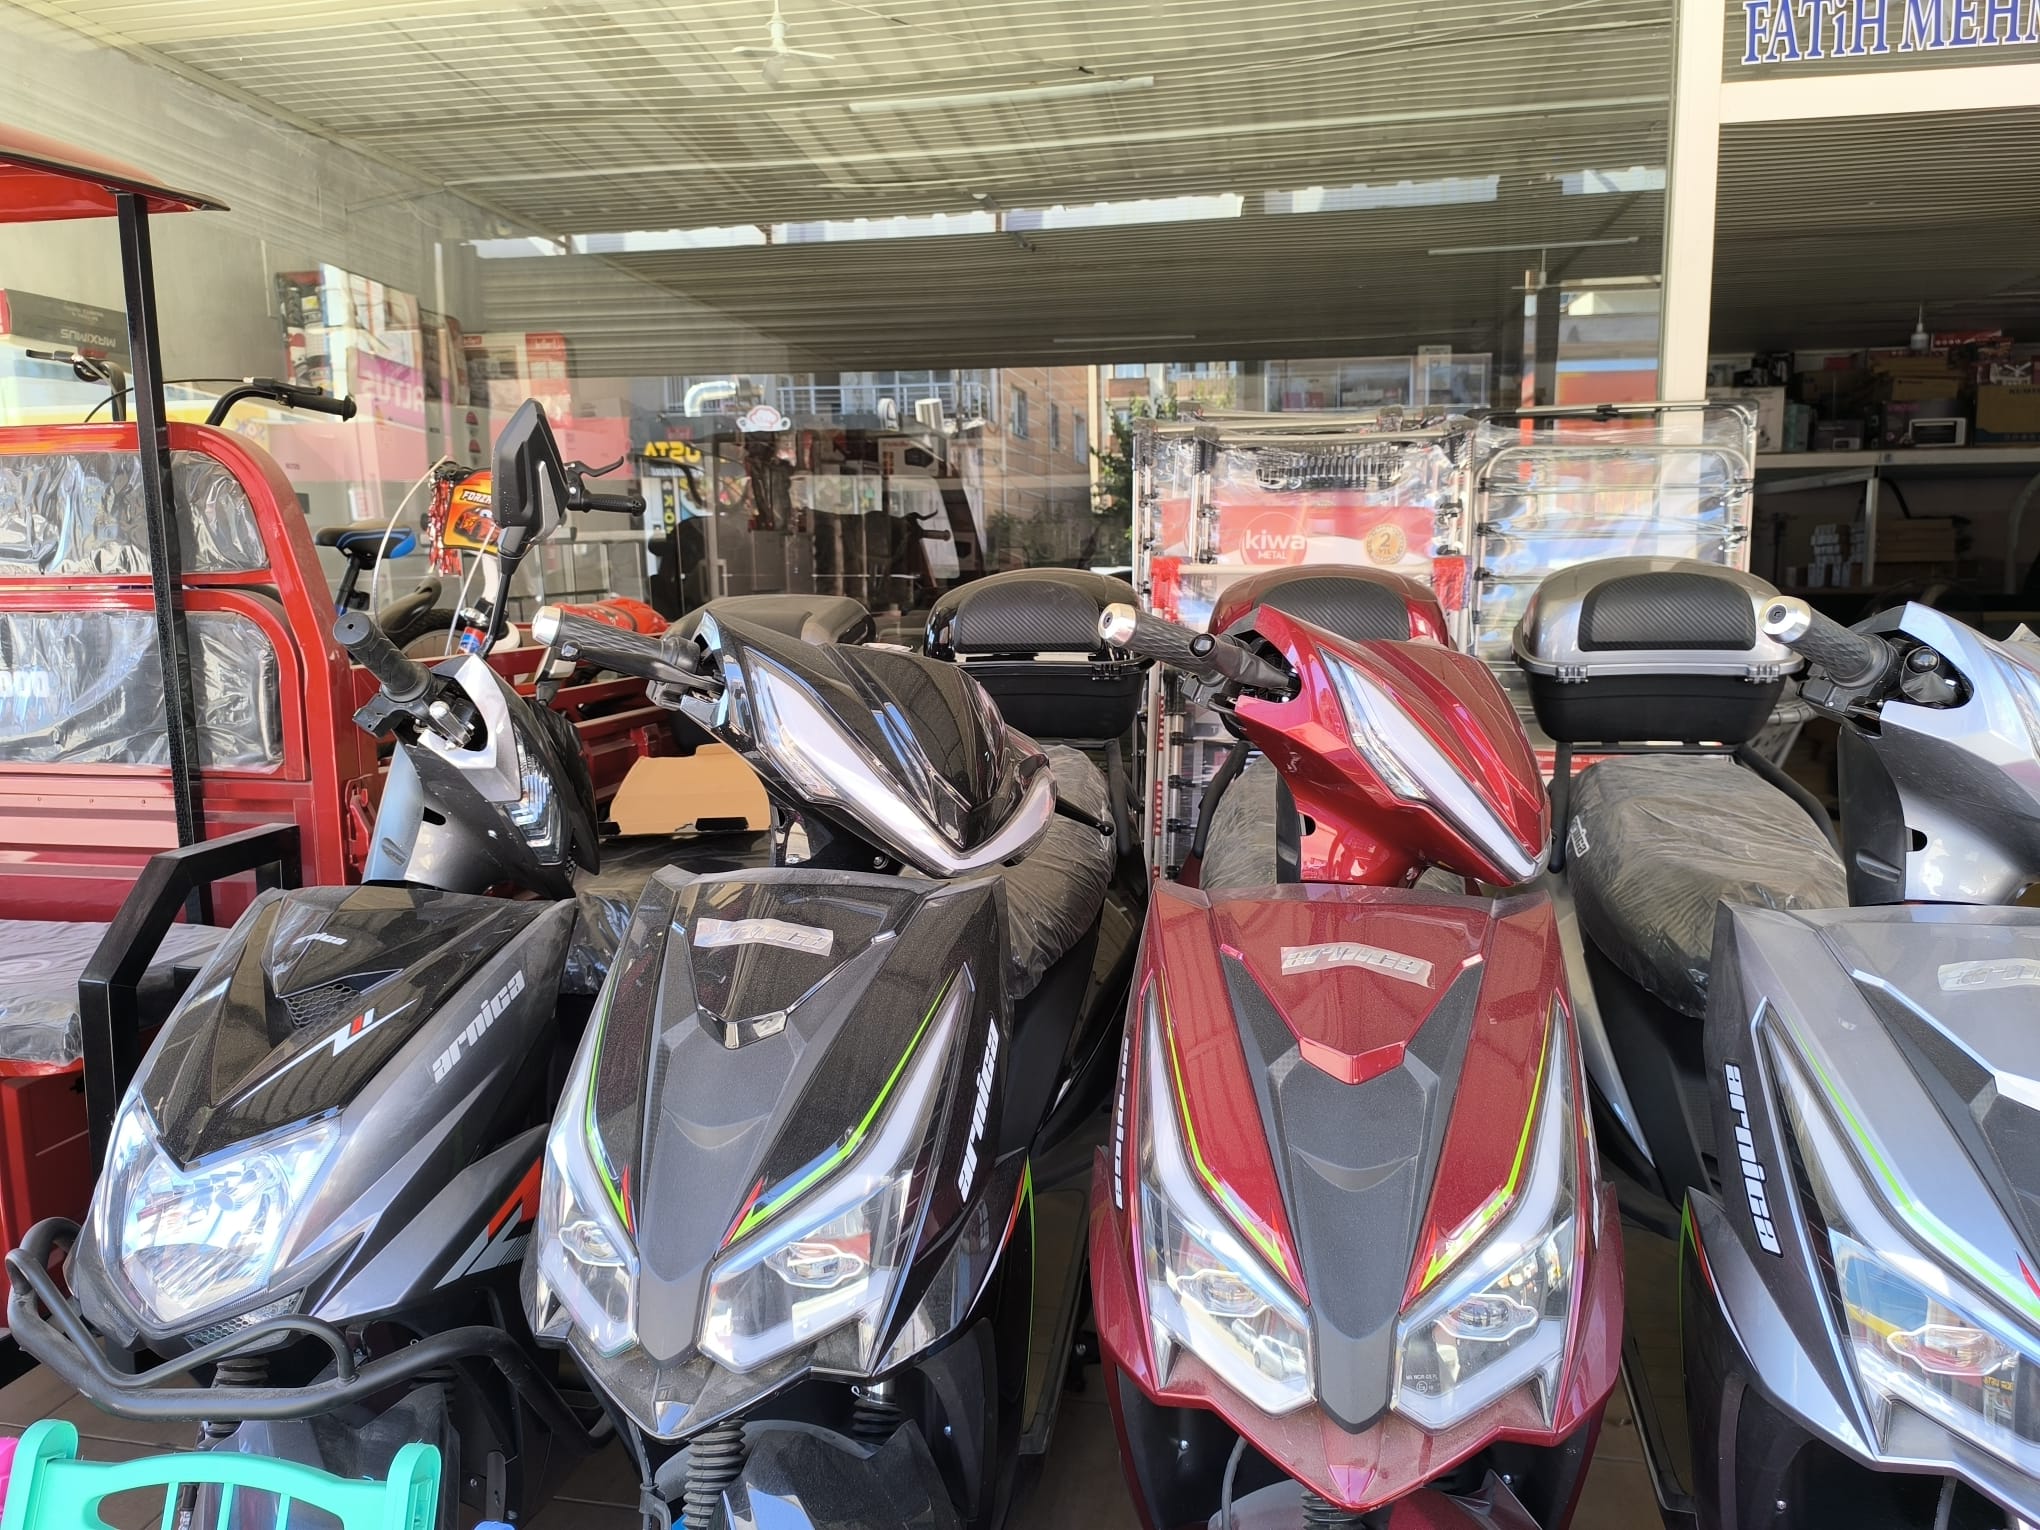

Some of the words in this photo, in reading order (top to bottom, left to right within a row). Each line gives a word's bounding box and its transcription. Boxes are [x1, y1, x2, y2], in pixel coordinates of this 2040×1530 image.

[1244, 529, 1306, 551] kiwa
[1379, 532, 1391, 547] 2
[1257, 551, 1287, 560] METAL
[1282, 944, 1424, 974] arnica
[432, 969, 526, 1084] arnica
[957, 1017, 1000, 1204] arnica
[1725, 1064, 1783, 1256] arnica
